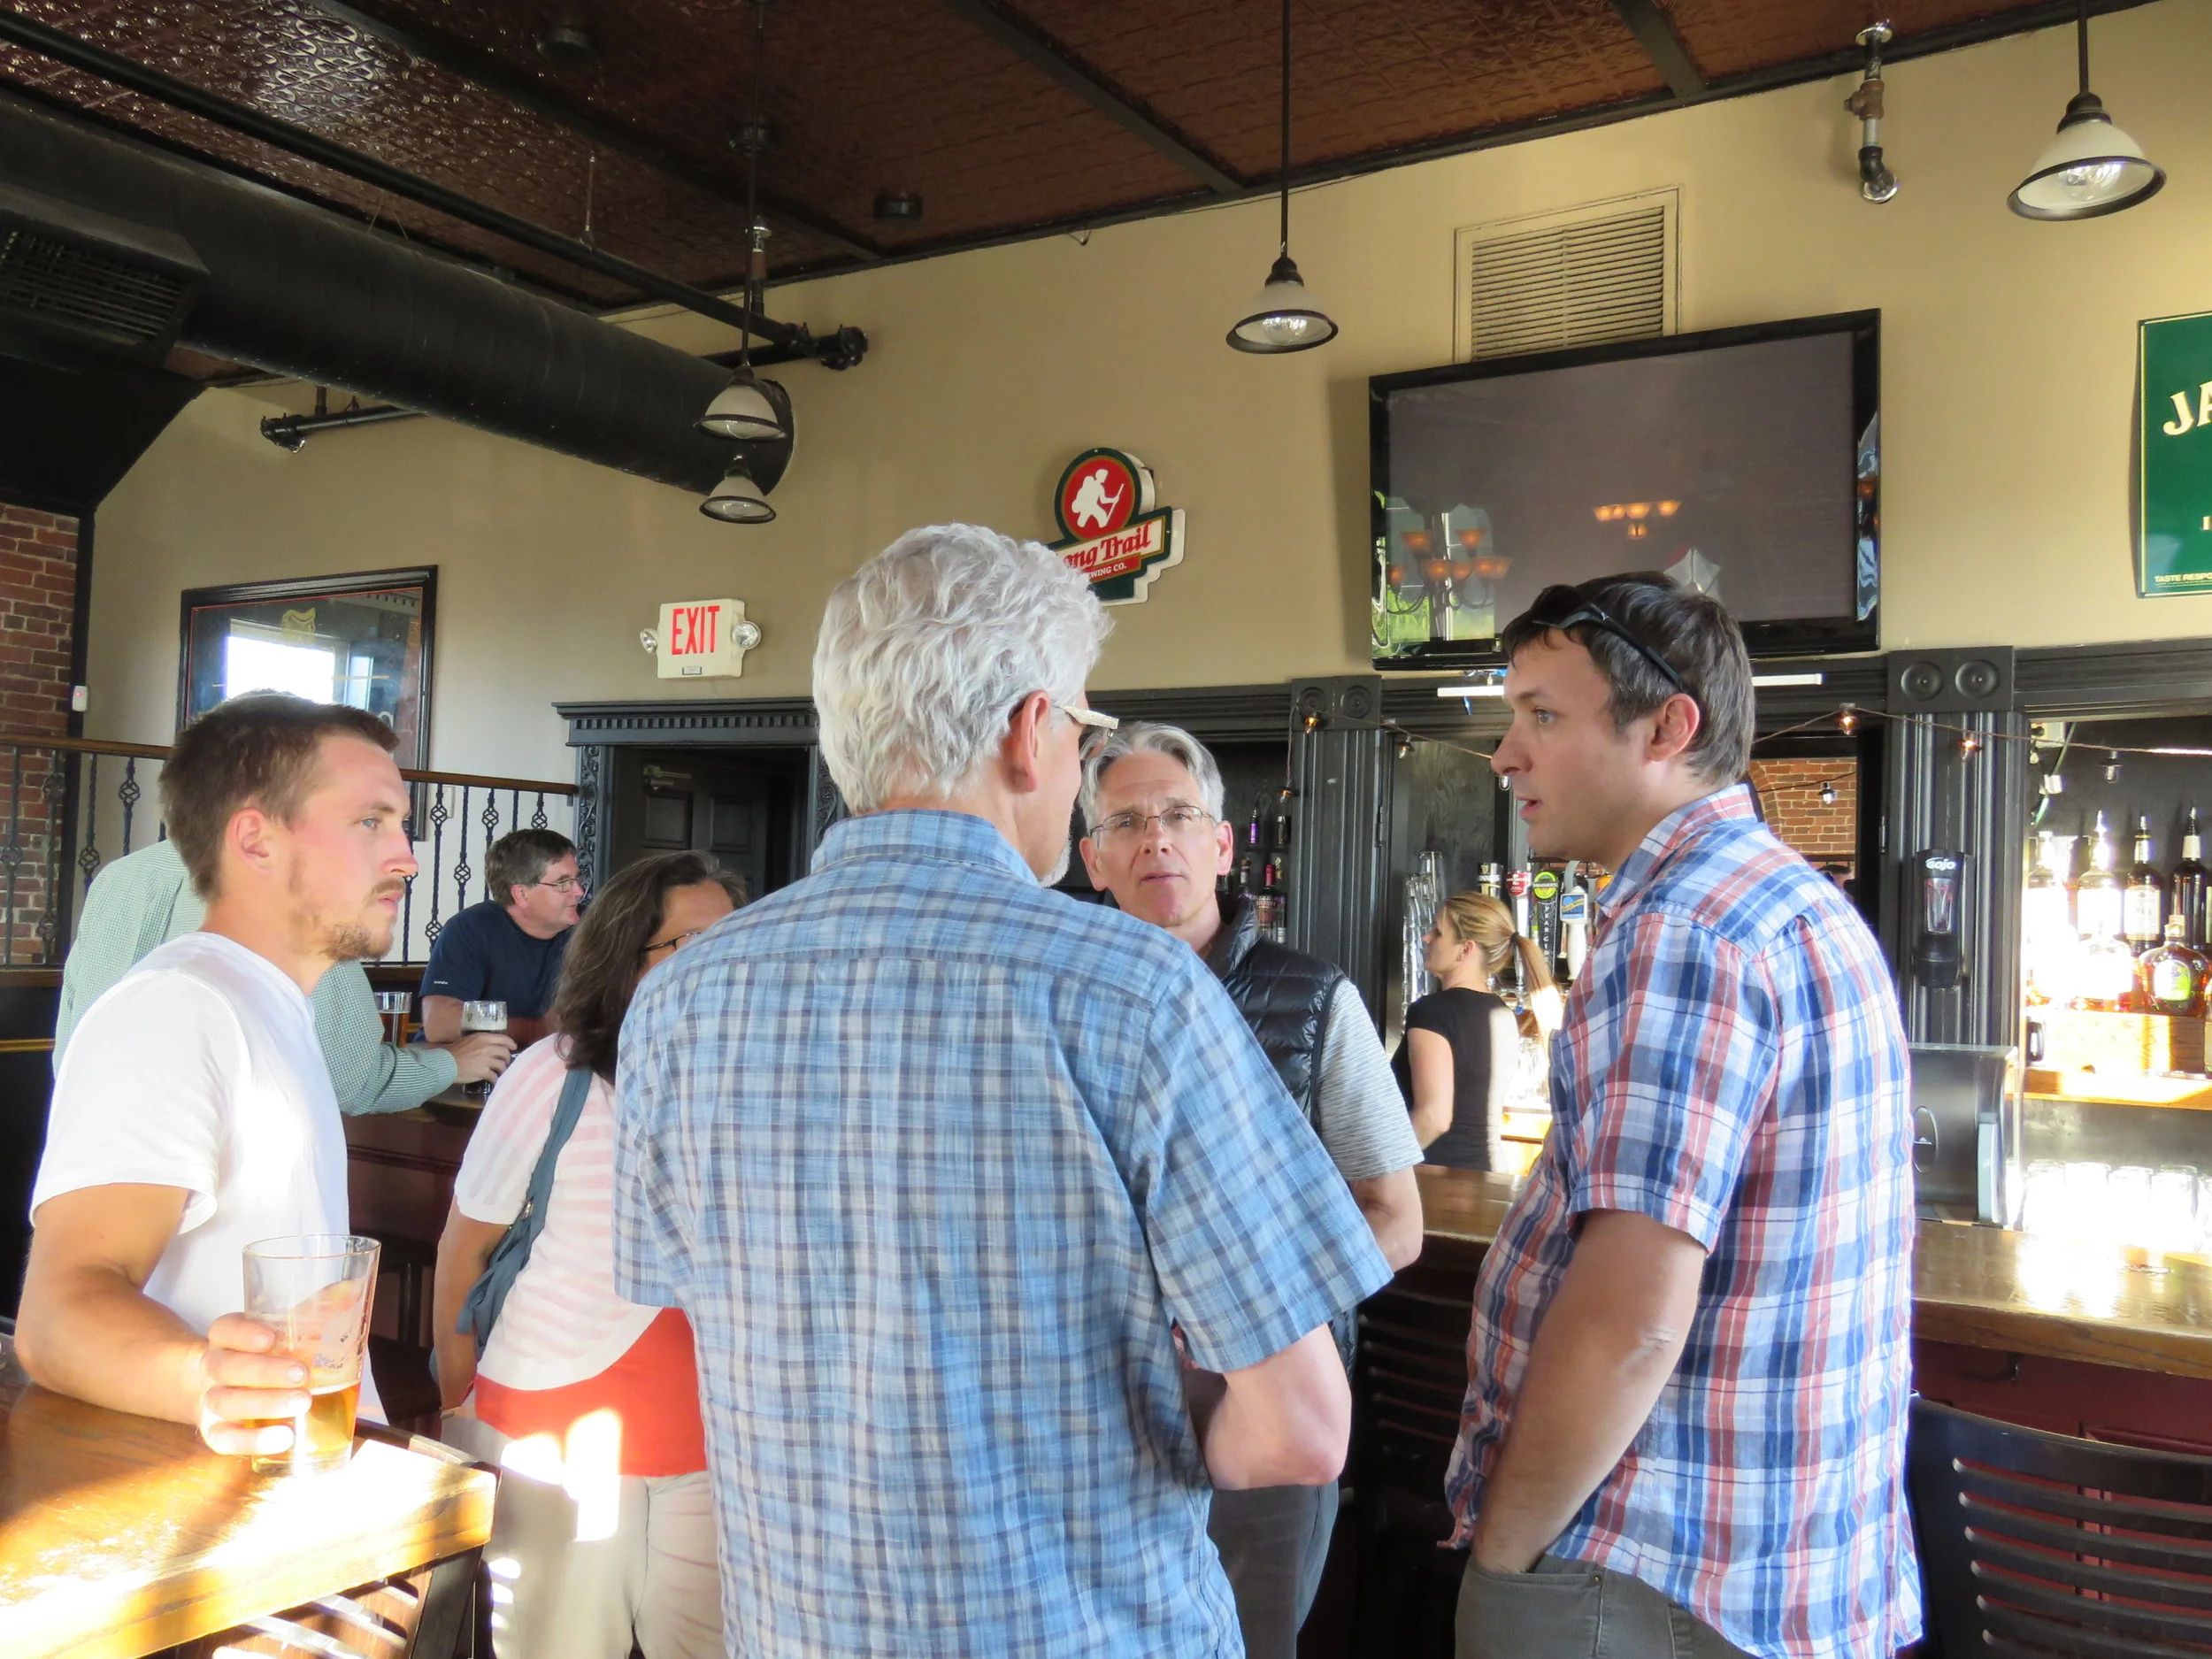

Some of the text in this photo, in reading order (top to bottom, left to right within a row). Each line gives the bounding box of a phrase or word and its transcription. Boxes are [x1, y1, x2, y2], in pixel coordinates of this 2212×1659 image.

[1062, 520, 1153, 569] ong Trail
[1090, 562, 1127, 579] WING CO.
[2154, 574, 2182, 583] TASTE
[672, 605, 720, 655] EXIT
